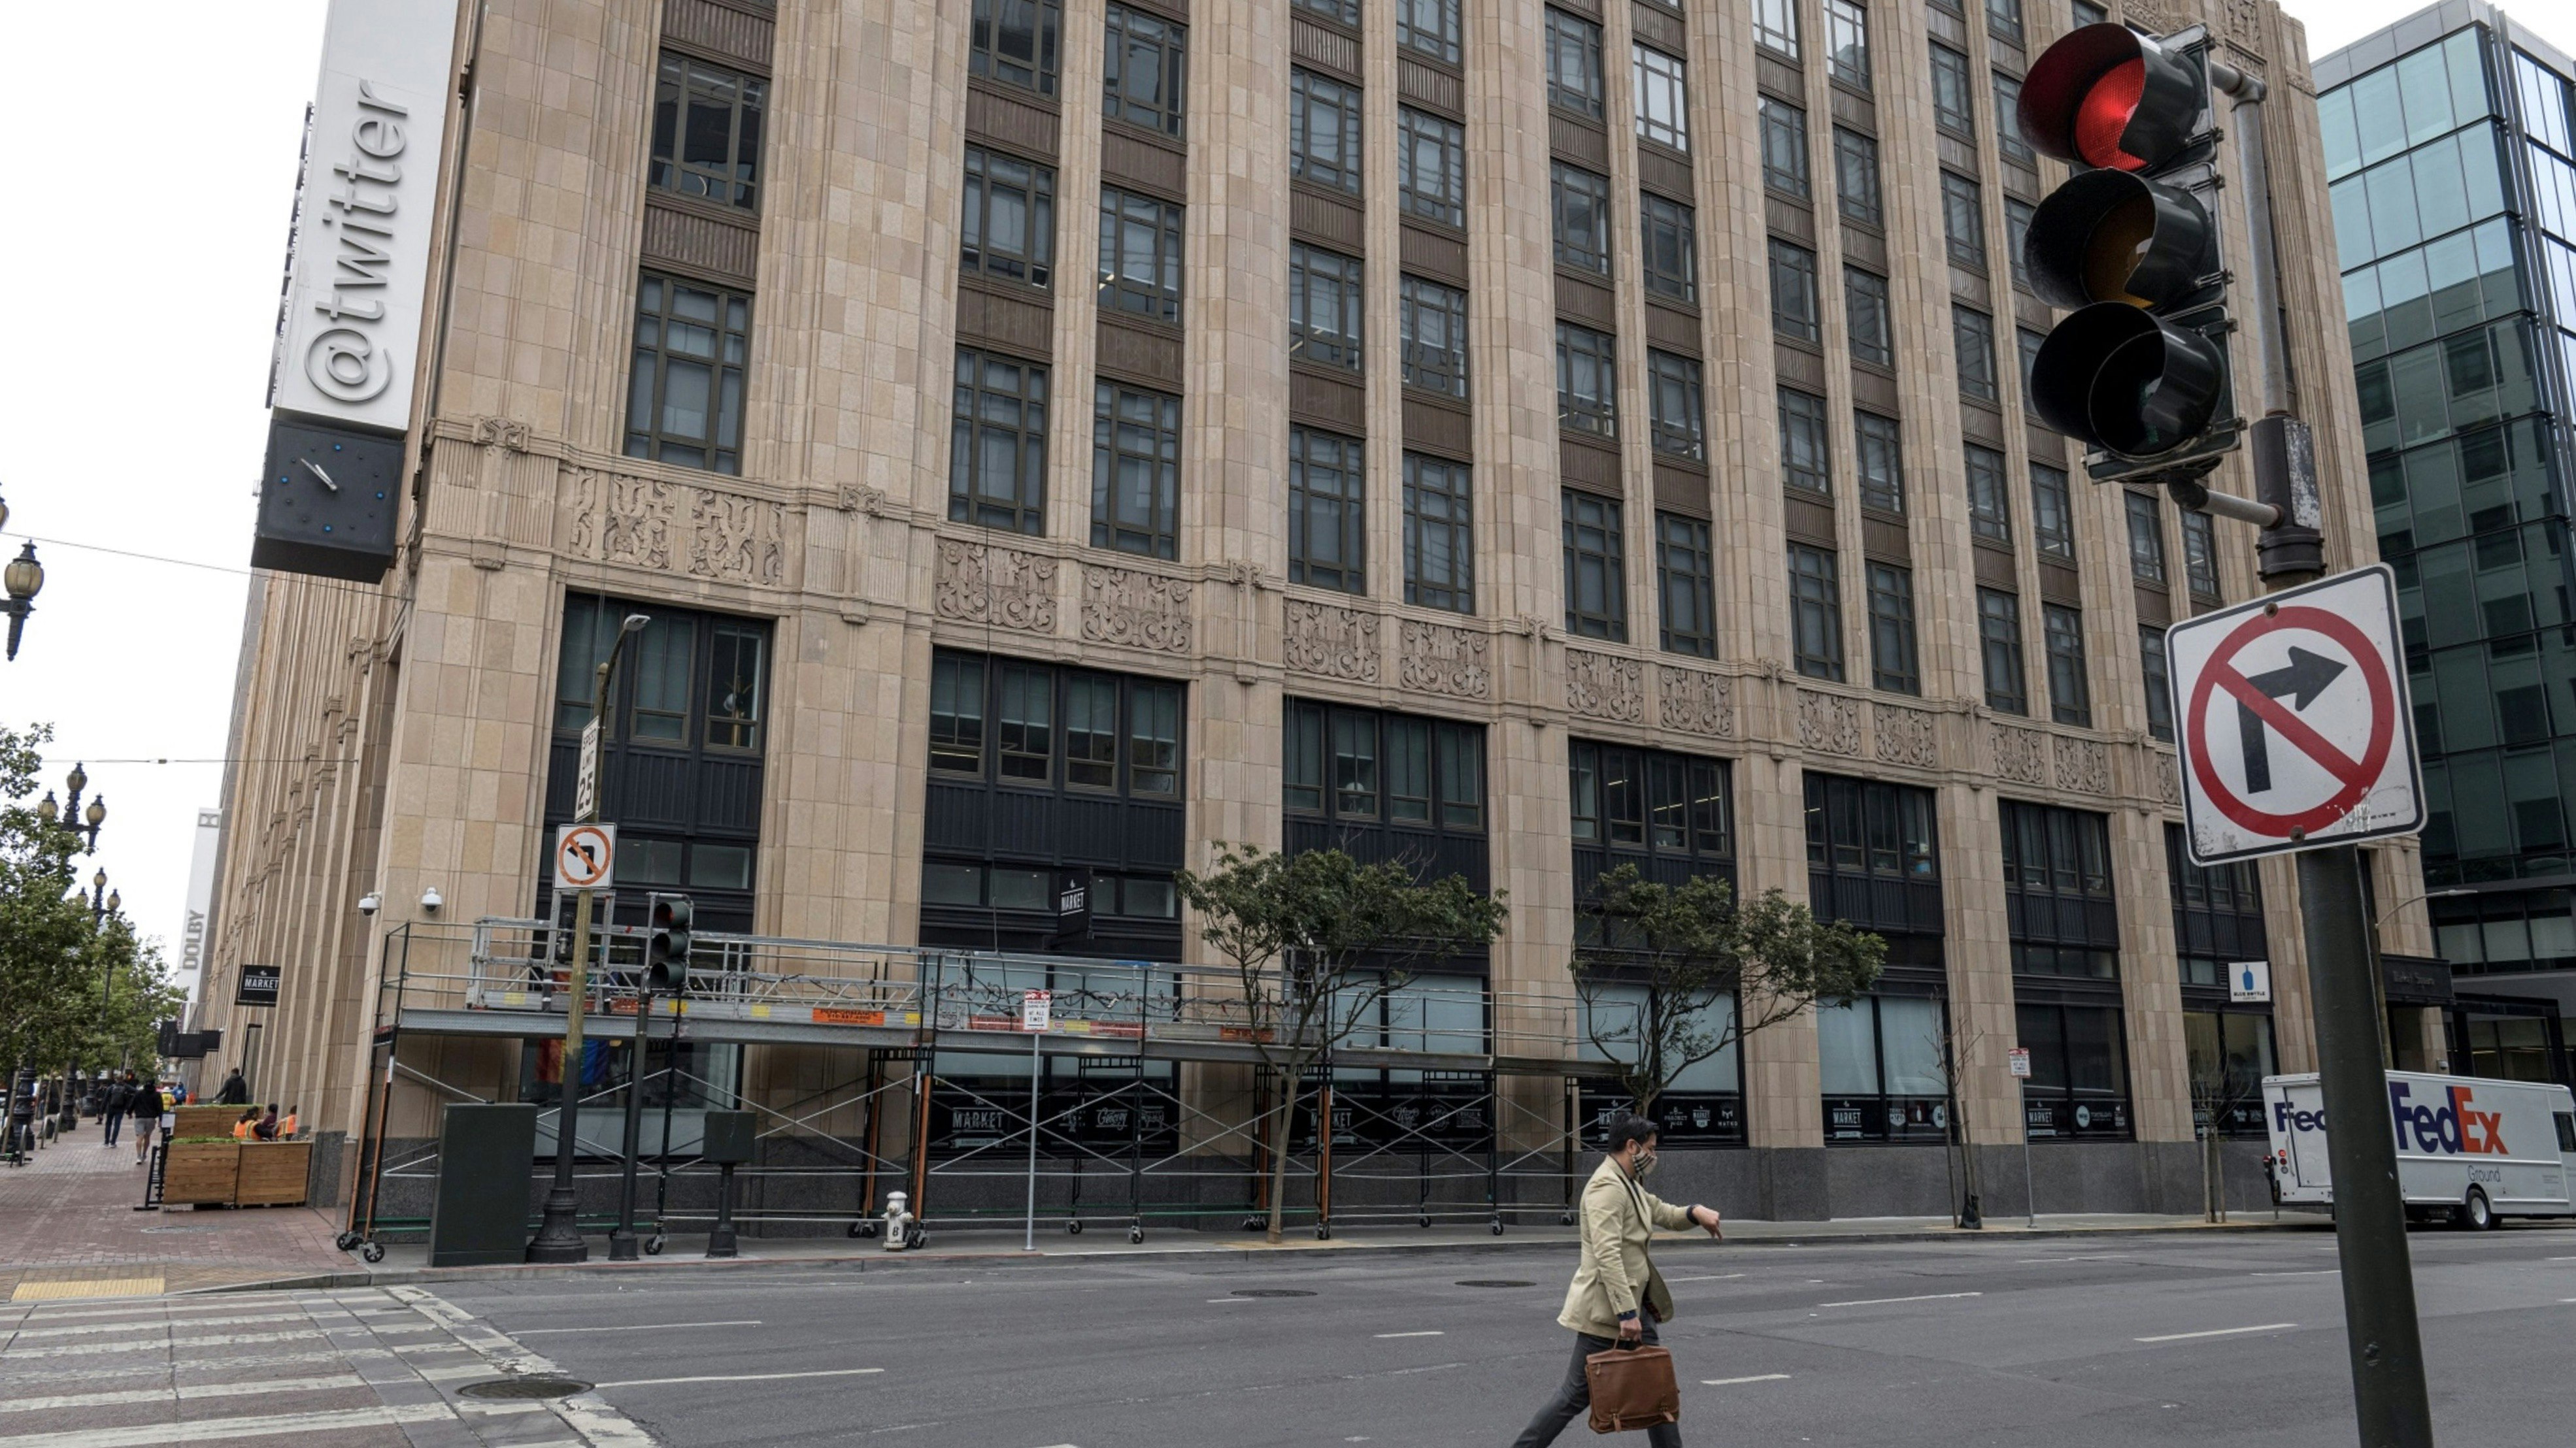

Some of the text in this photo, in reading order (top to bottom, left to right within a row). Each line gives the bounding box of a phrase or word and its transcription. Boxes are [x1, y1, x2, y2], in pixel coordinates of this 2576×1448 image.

[304, 79, 407, 403] @twitter
[578, 771, 593, 812] 25
[1062, 893, 1084, 912] MARKET
[183, 909, 205, 970] DOLBY
[244, 978, 279, 989] MARKET
[952, 1111, 1003, 1128] MARKET
[1311, 1112, 1352, 1127] MKET
[1833, 1112, 1861, 1124] MARKET
[2029, 1111, 2052, 1123] MARKET
[2388, 1081, 2509, 1155] FedEx
[2467, 1164, 2501, 1182] Ground
